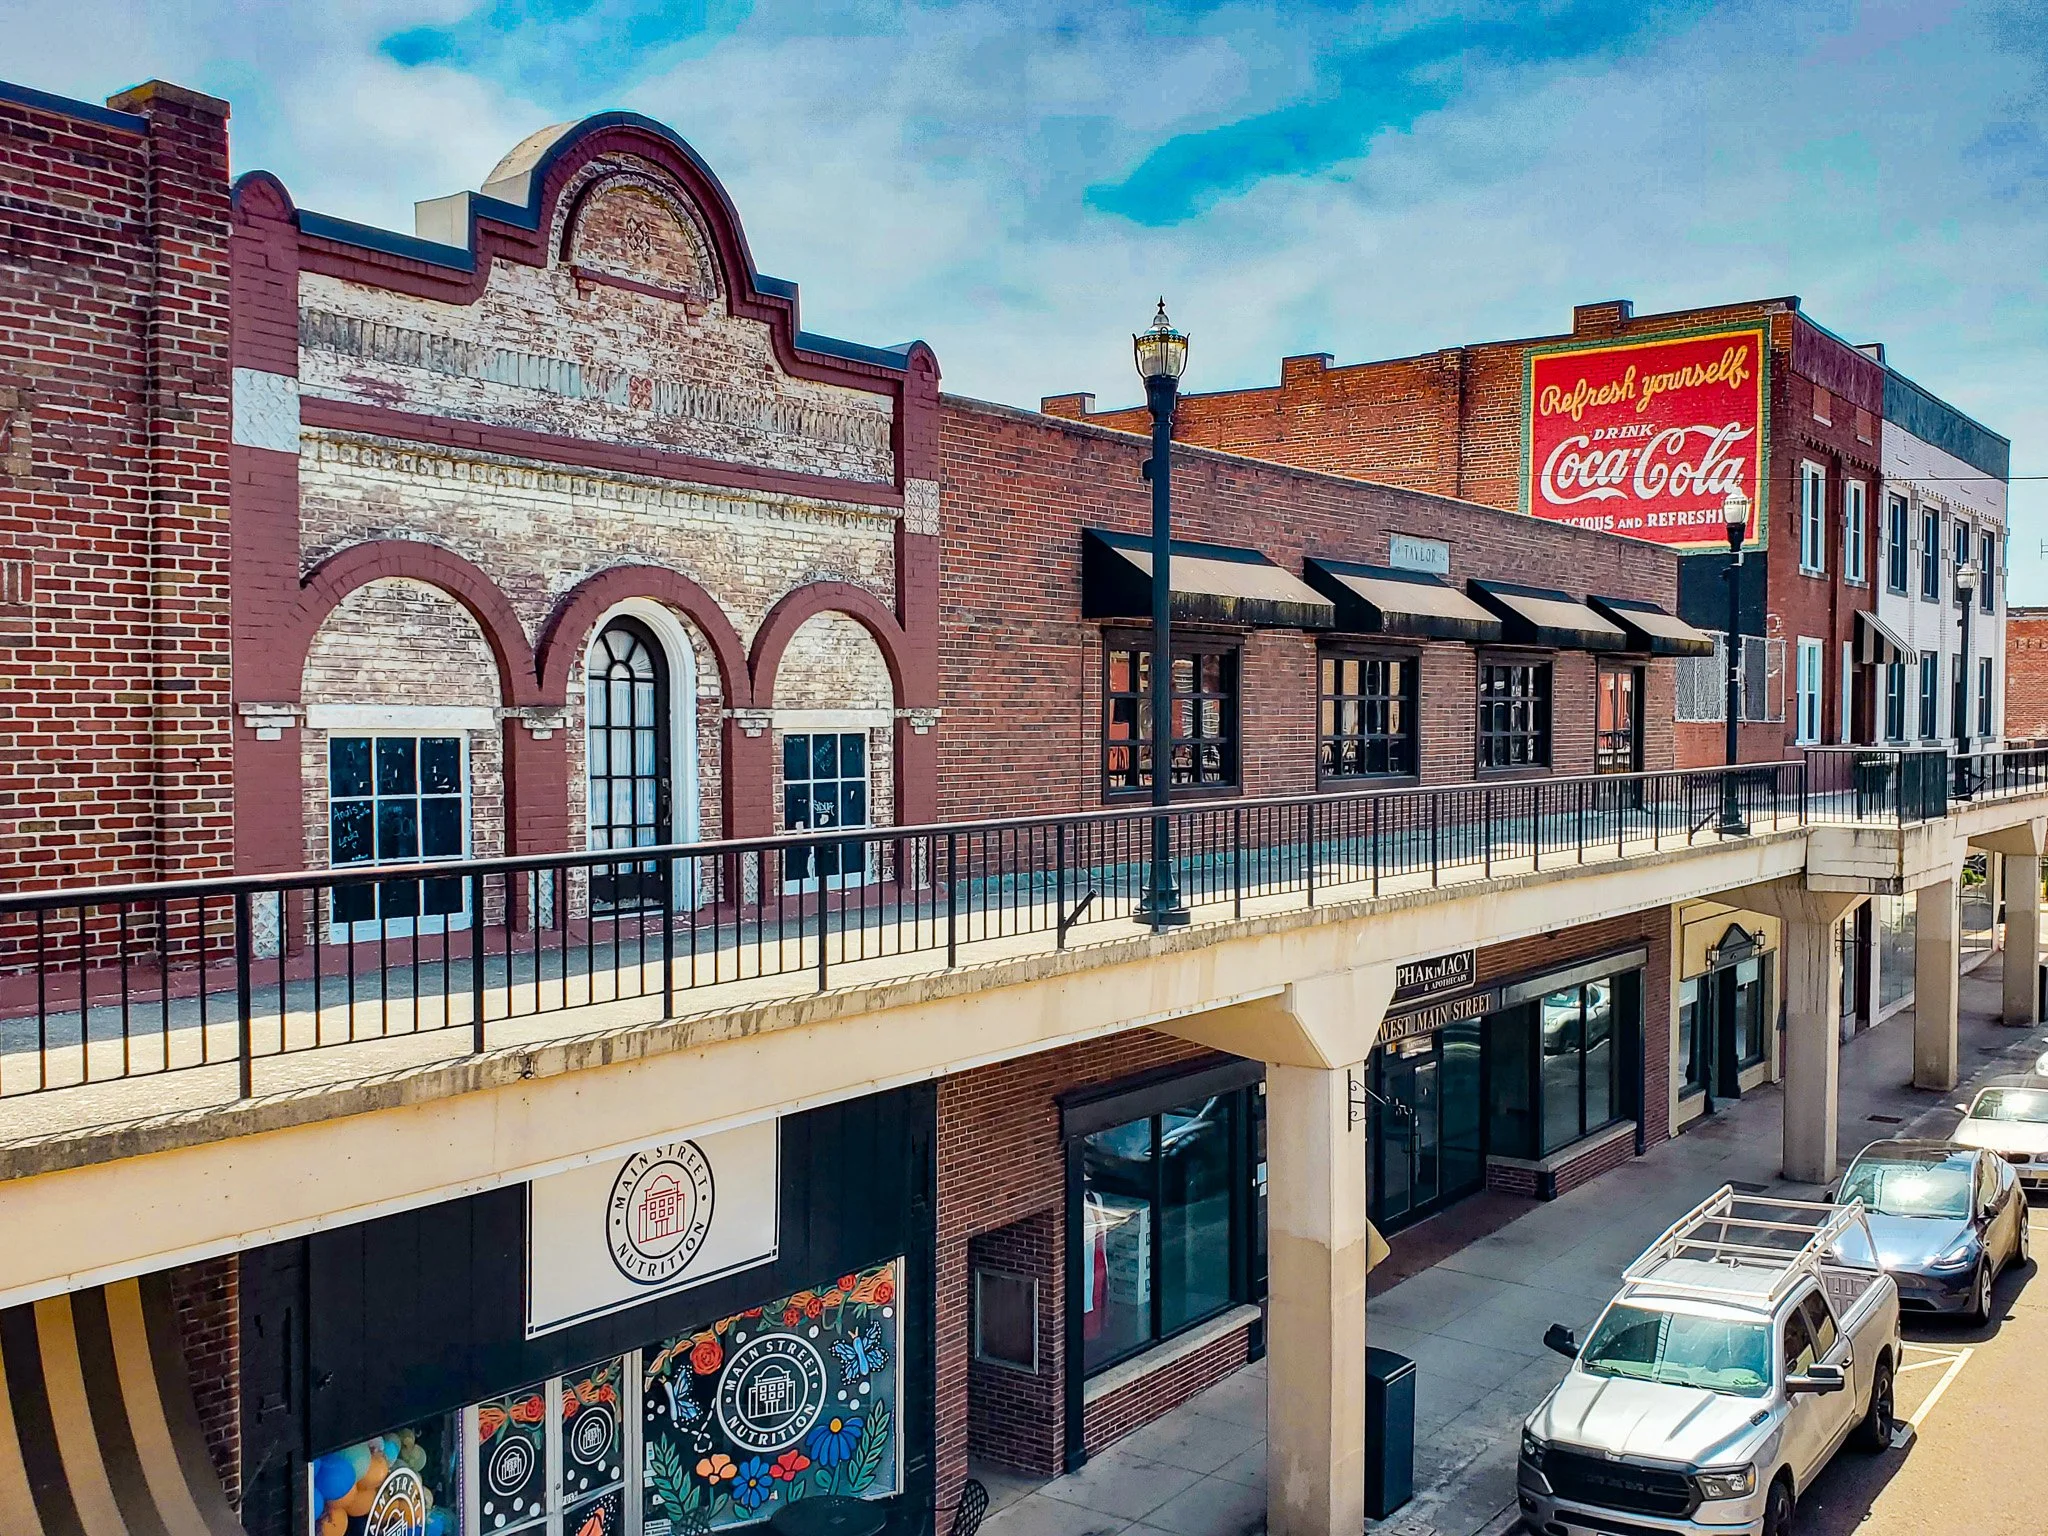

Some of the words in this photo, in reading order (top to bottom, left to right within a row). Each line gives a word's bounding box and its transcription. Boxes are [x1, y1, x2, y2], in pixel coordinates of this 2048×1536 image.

[1540, 365, 1636, 422] Refresh
[1636, 345, 1750, 413] yourself
[1592, 424, 1655, 441] DRINK
[1617, 519, 1643, 529] AND
[1647, 509, 1723, 527] REFRESHI
[1404, 544, 1436, 564] TAYLOR
[1397, 952, 1471, 987] PHARMACY
[1424, 982, 1429, 992] &
[1431, 973, 1467, 990] APOTHECARY
[1379, 1016, 1411, 1042] WEST
[1414, 1004, 1448, 1033] MAIN
[1452, 993, 1491, 1021] STREET
[615, 1153, 649, 1209] MAIN
[656, 1143, 708, 1187] STREET
[617, 1221, 705, 1277] NUTRITION
[724, 1349, 760, 1391] MAIN
[766, 1339, 820, 1377] STREET
[726, 1401, 816, 1446] NUTRITION
[389, 1477, 422, 1512] STREET
